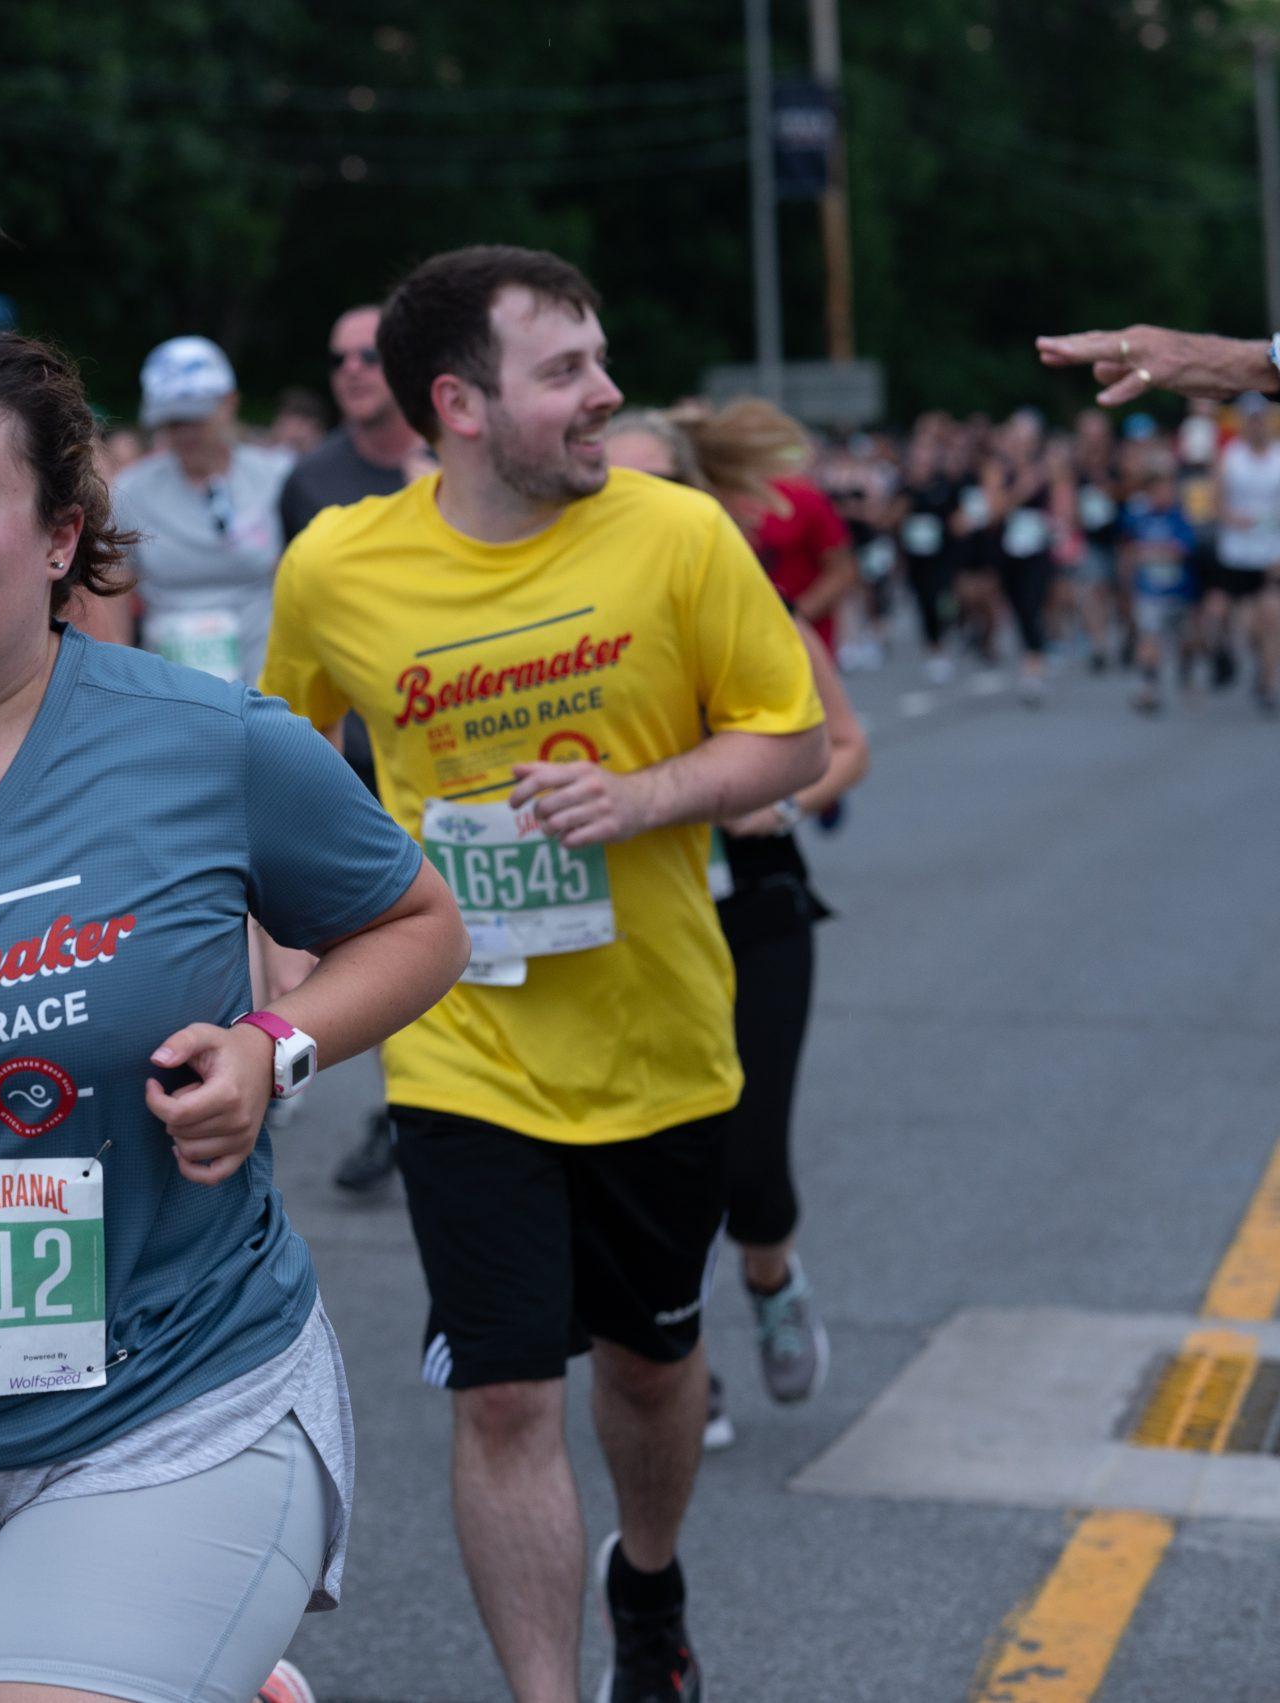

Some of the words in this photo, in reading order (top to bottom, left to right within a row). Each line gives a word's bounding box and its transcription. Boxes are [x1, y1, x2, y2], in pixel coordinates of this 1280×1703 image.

[396, 632, 634, 730] Boilermaker
[464, 707, 531, 742] ROAD
[538, 686, 604, 725] RACE
[437, 845, 590, 909] 16545
[10, 1371, 81, 1389] Wolfspeed
